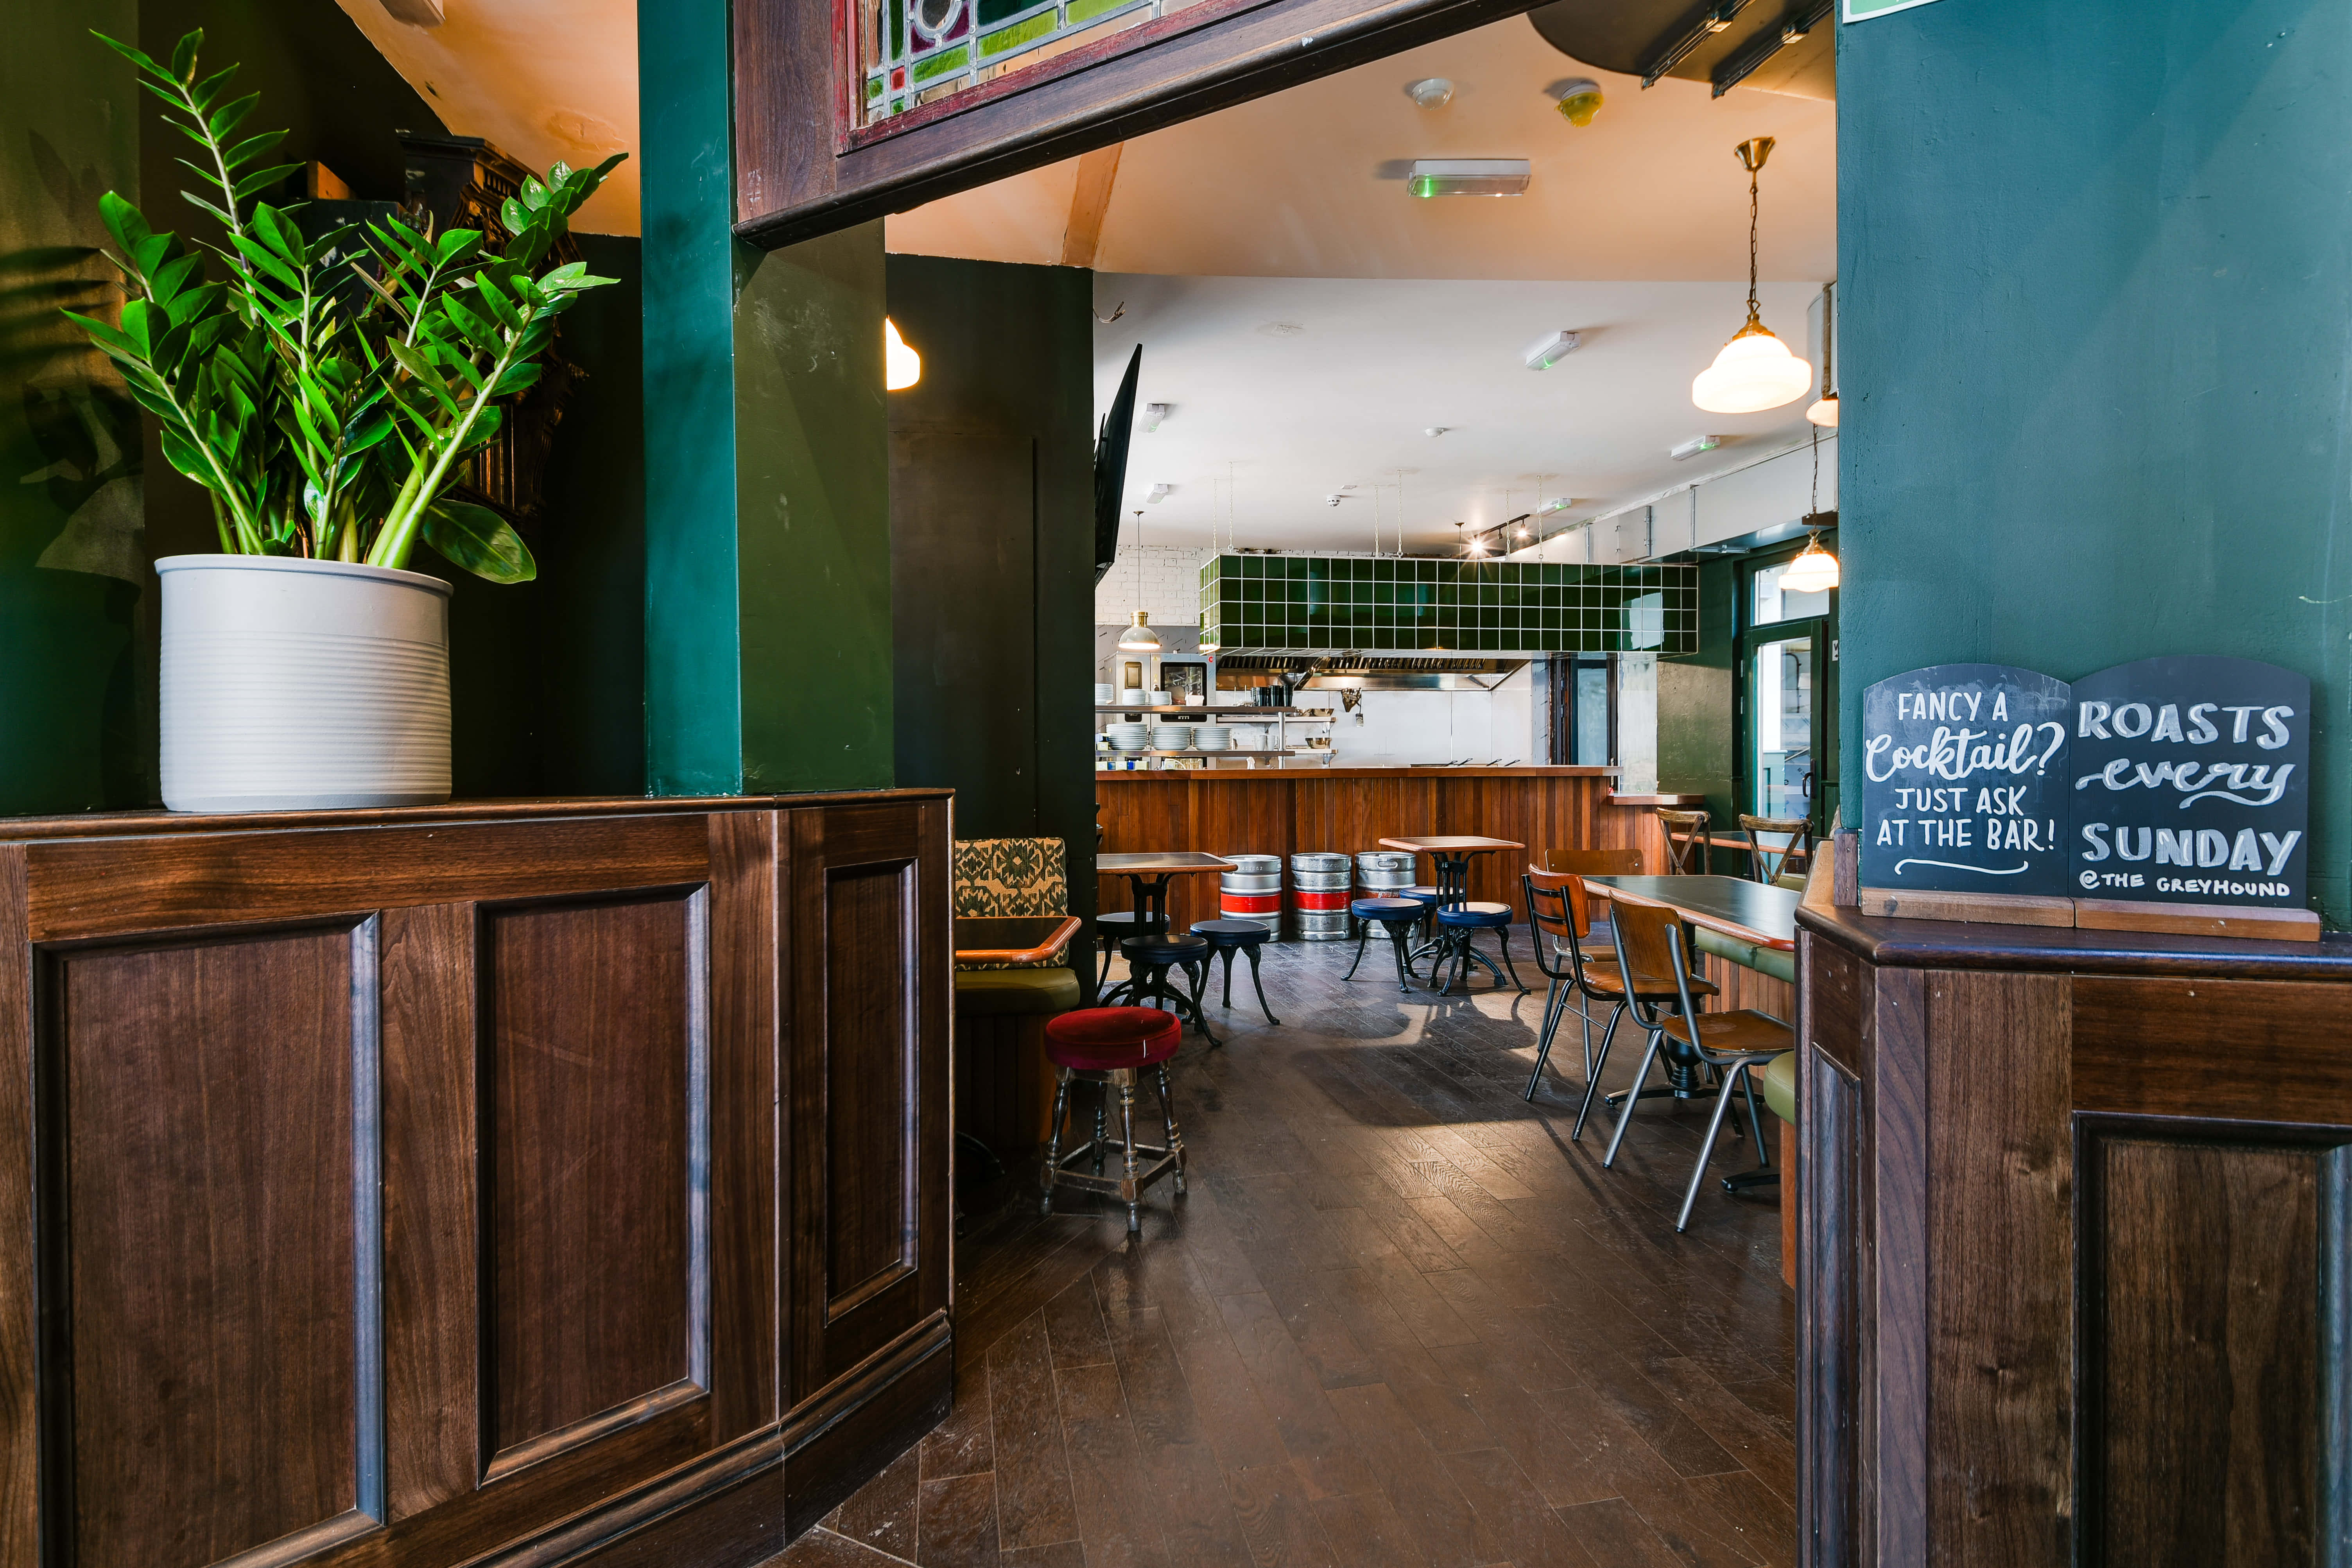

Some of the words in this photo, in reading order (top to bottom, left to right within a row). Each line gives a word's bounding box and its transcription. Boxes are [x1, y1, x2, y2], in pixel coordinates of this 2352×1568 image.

[1898, 691, 1982, 722] FANCY
[1992, 692, 2008, 722] A
[2078, 701, 2295, 749] ROASTS
[1866, 722, 2065, 782] Cocktail?
[1895, 787, 1968, 812] JUST
[1976, 785, 2027, 816] ASK
[2075, 758, 2296, 809] every
[1876, 819, 1909, 846] AT
[1918, 818, 1972, 848] THE
[1987, 818, 2054, 851] BAR!
[2081, 822, 2302, 876] SUNDAY
[2156, 877, 2290, 897] GREYHOUND
